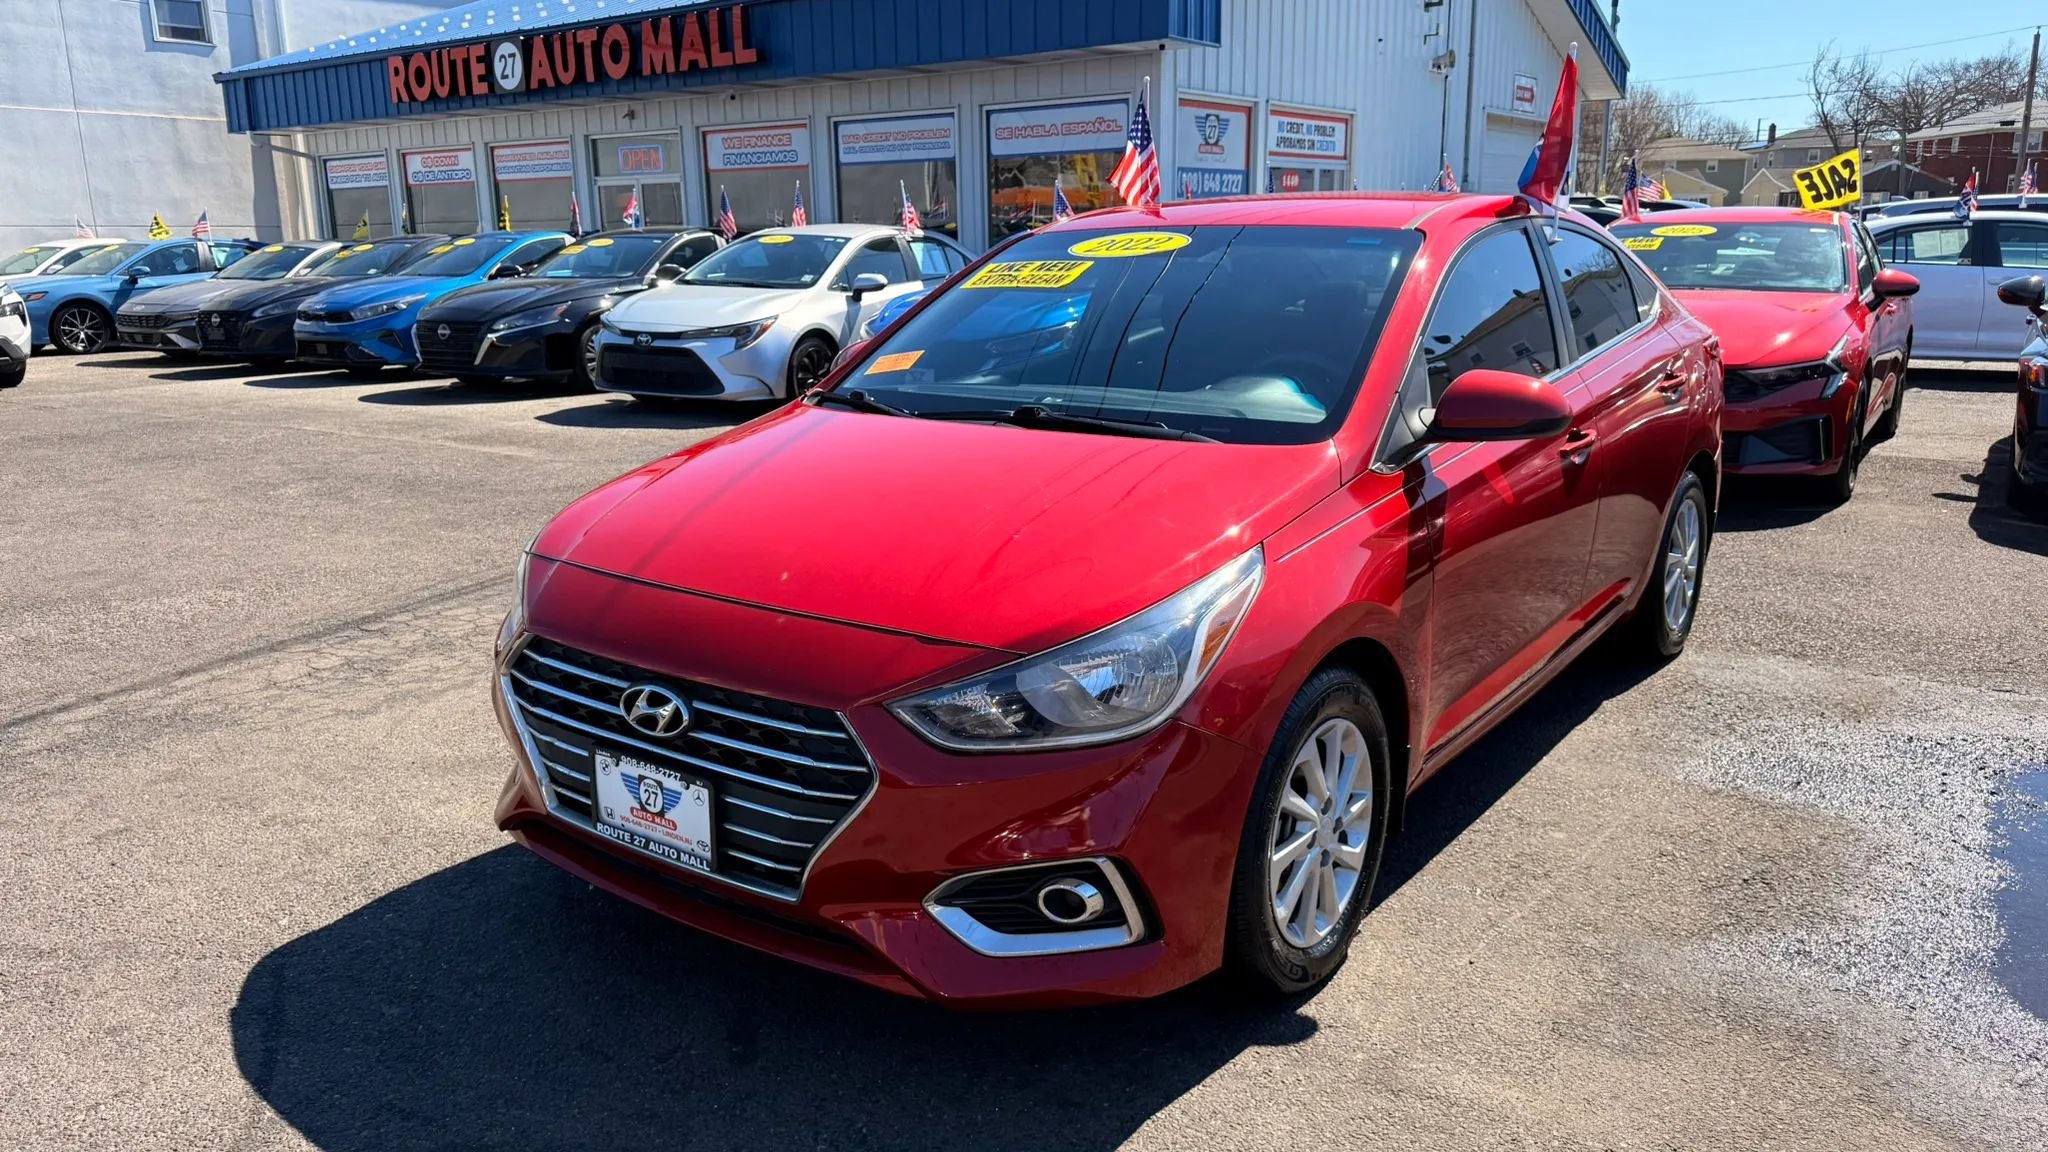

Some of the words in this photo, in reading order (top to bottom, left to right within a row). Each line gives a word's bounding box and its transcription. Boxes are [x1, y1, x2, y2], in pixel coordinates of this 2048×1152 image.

[387, 43, 488, 103] ROUTE
[499, 52, 517, 80] 27
[530, 23, 630, 89] AUTO
[642, 5, 757, 76] MALL
[842, 133, 860, 145] BAD
[862, 132, 892, 143] CREDIT
[892, 131, 906, 141] NO
[907, 128, 951, 140] PROBLEM
[995, 127, 1013, 140] SE
[1014, 124, 1059, 139] HABLA
[1060, 117, 1123, 136] ESPAÑOL
[1207, 125, 1217, 140] 27
[1314, 124, 1336, 137] PROBLEM
[721, 136, 742, 150] WE
[742, 133, 792, 149] FINANCE
[433, 155, 459, 168] DOWN
[622, 149, 660, 170] OPEN
[723, 150, 798, 166] FINANCIAMOS
[424, 170, 436, 182] DE
[436, 168, 471, 181] ANTICIPO
[1203, 172, 1220, 193] 648
[1221, 173, 1243, 193] 2727
[1083, 236, 1174, 253] 2022
[985, 262, 1034, 274] LIKE
[1029, 261, 1084, 273] NEW
[642, 781, 659, 790] ROUTE
[643, 788, 659, 809] 27
[632, 808, 652, 822] AUTO
[654, 815, 675, 830] MALL
[596, 822, 632, 843] ROUTE
[633, 835, 646, 848] 27
[648, 841, 678, 859] AUTO
[680, 852, 711, 872] MALL
